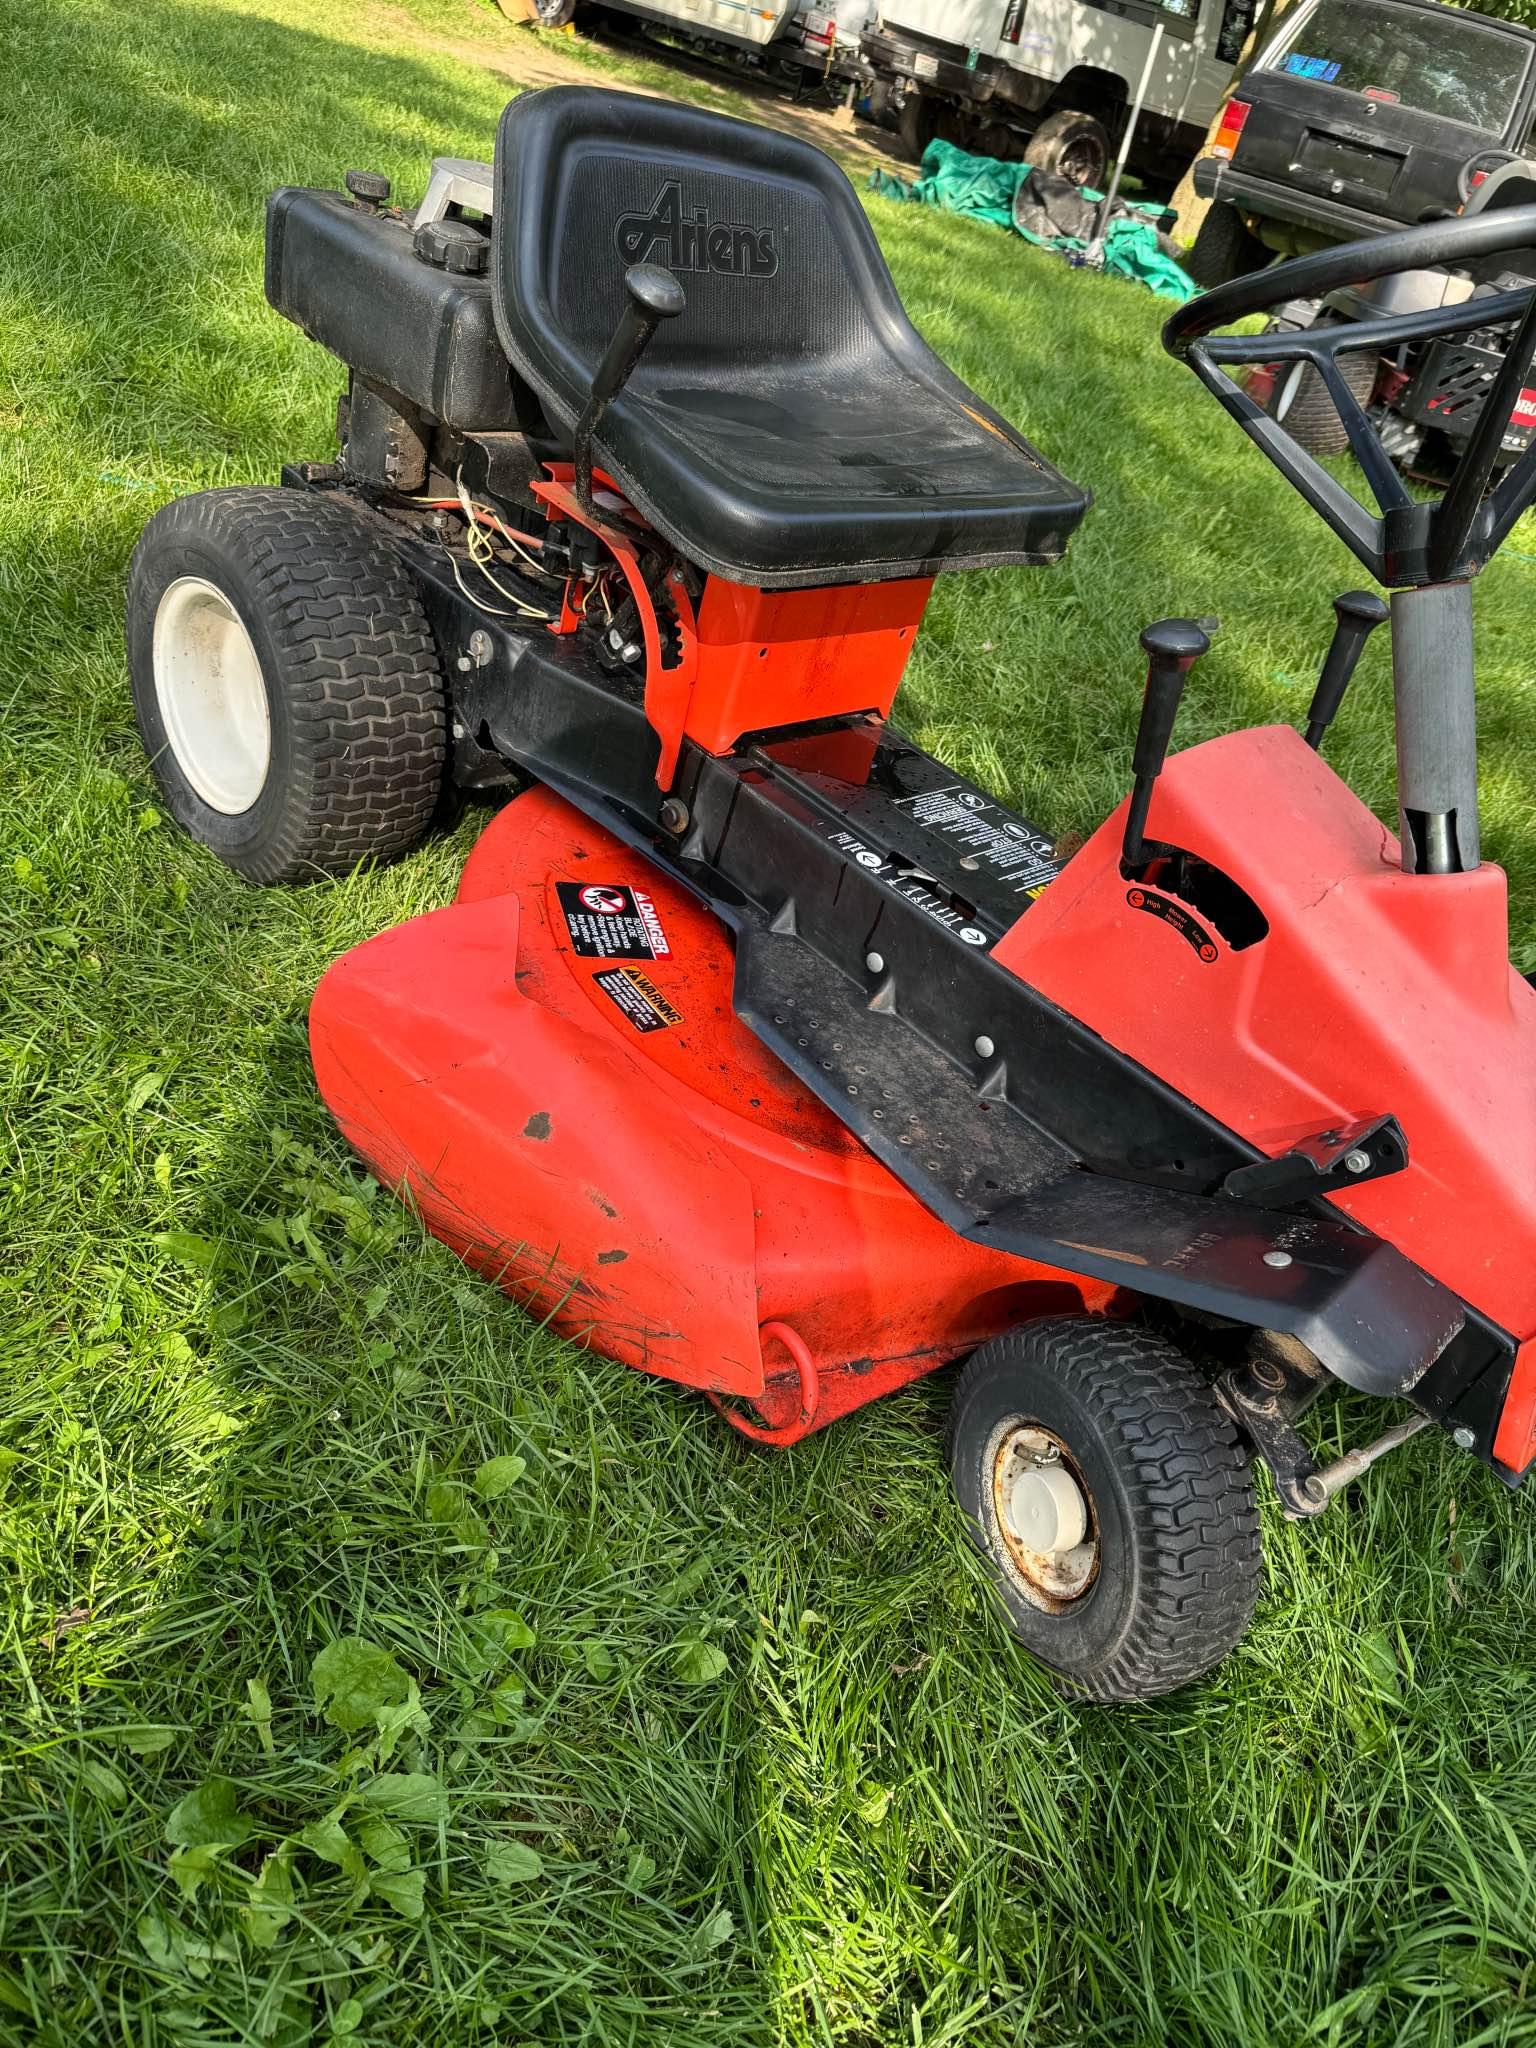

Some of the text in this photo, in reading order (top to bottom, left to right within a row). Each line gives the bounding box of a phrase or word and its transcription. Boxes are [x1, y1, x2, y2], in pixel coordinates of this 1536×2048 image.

[614, 179, 779, 279] Ariens
[925, 806, 967, 822] SERVICING
[991, 837, 1013, 848] STOP
[1146, 899, 1160, 909] High
[1165, 914, 1184, 929] Height
[1168, 907, 1187, 923] Mower
[624, 917, 637, 938] BLADE
[633, 917, 649, 947] ROTATING
[640, 903, 669, 954] DANGER
[620, 931, 631, 949] hands
[1192, 930, 1202, 943] Low
[636, 978, 681, 1022] WARNING
